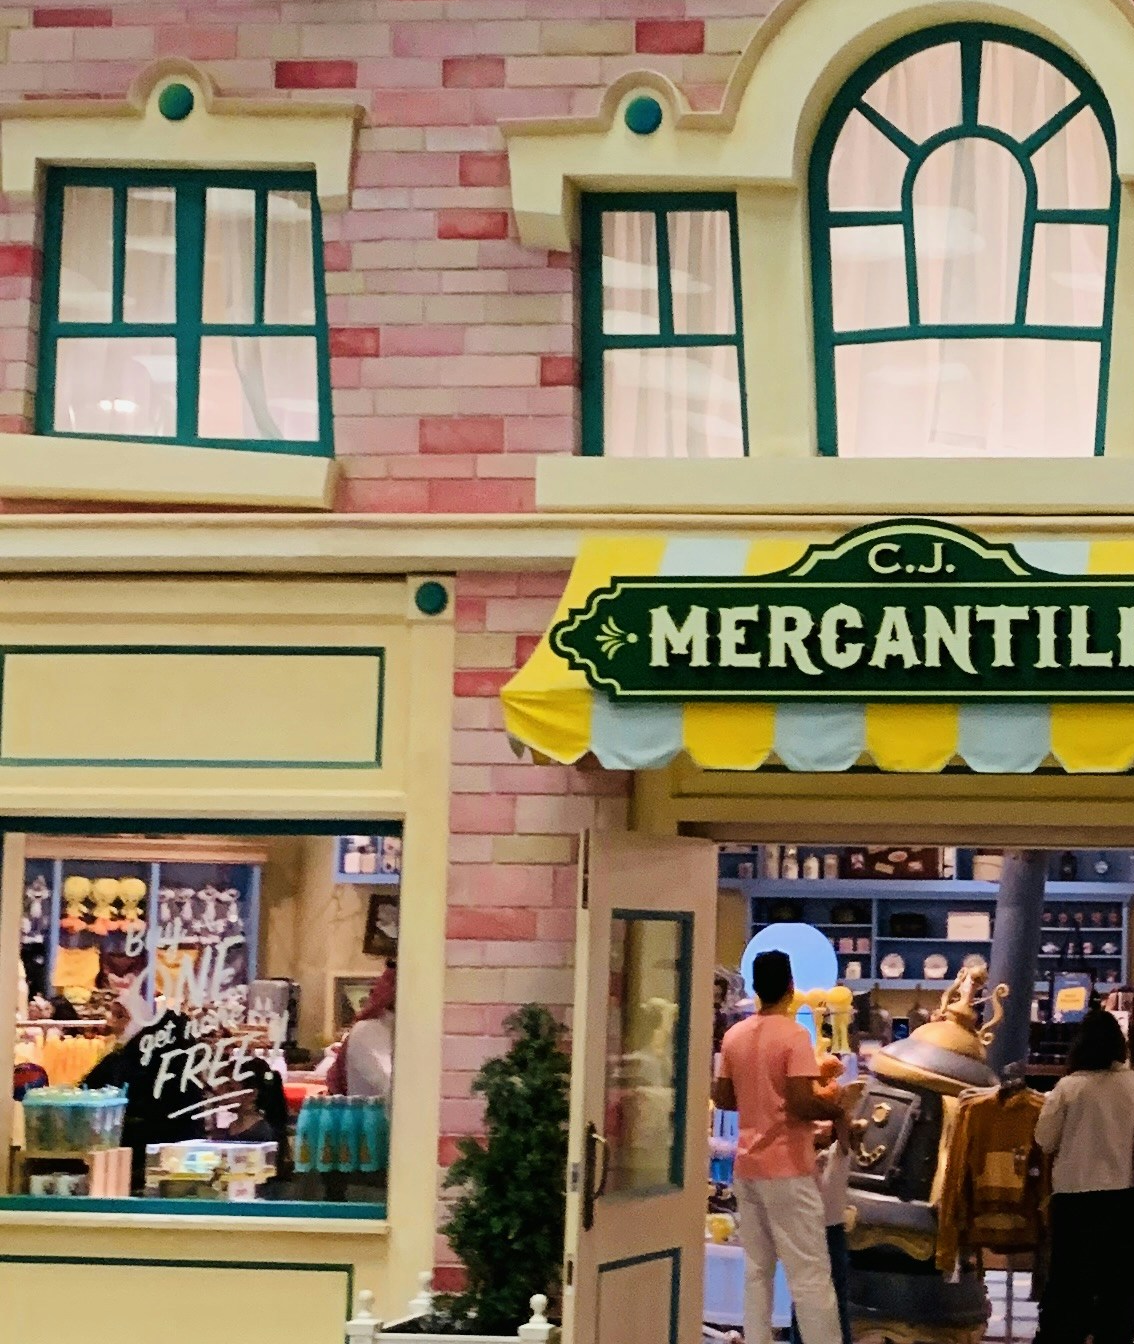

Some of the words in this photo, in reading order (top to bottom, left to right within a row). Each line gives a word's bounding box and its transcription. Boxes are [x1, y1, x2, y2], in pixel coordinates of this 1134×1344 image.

[867, 542, 956, 574] C.J.
[130, 935, 247, 1028] ONE
[139, 1020, 177, 1067] get
[153, 1010, 289, 1100] FREE!
